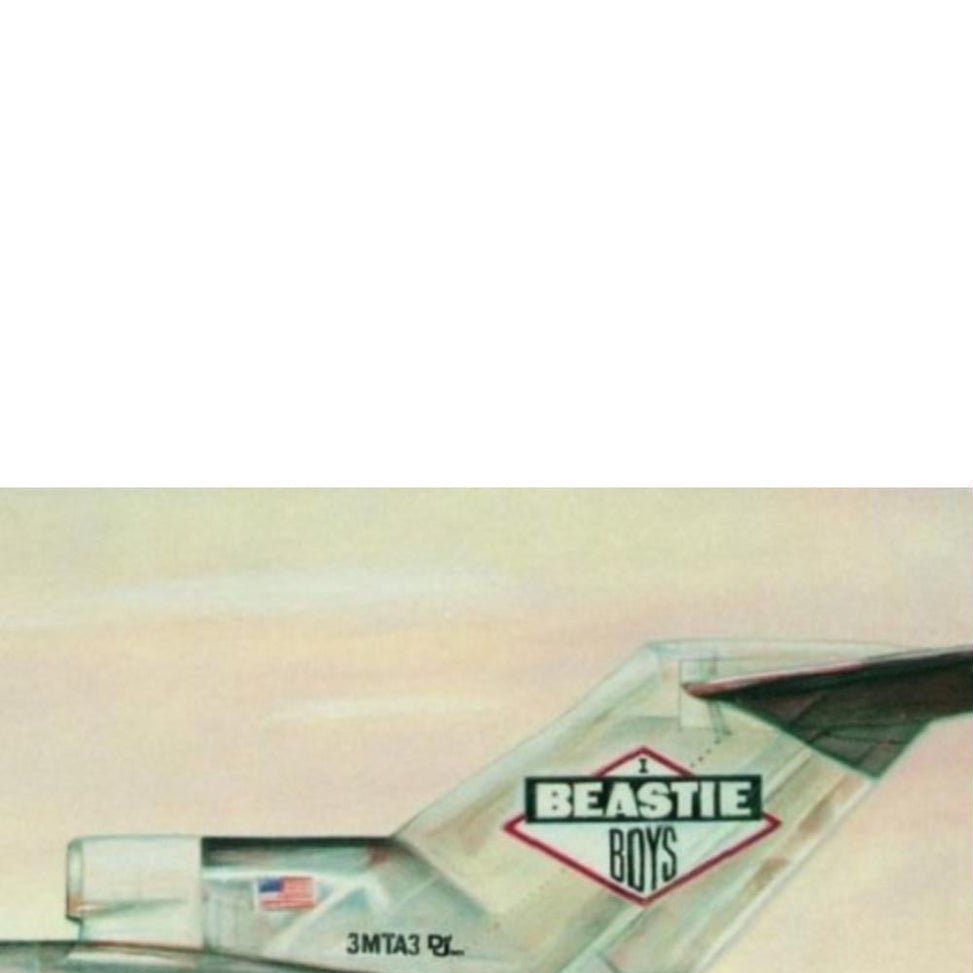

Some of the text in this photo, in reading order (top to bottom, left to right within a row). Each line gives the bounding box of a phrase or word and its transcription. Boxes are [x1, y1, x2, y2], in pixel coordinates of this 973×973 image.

[534, 780, 752, 820] BEASTIE
[609, 825, 678, 893] BOYS
[346, 932, 420, 956] 3MTA3
